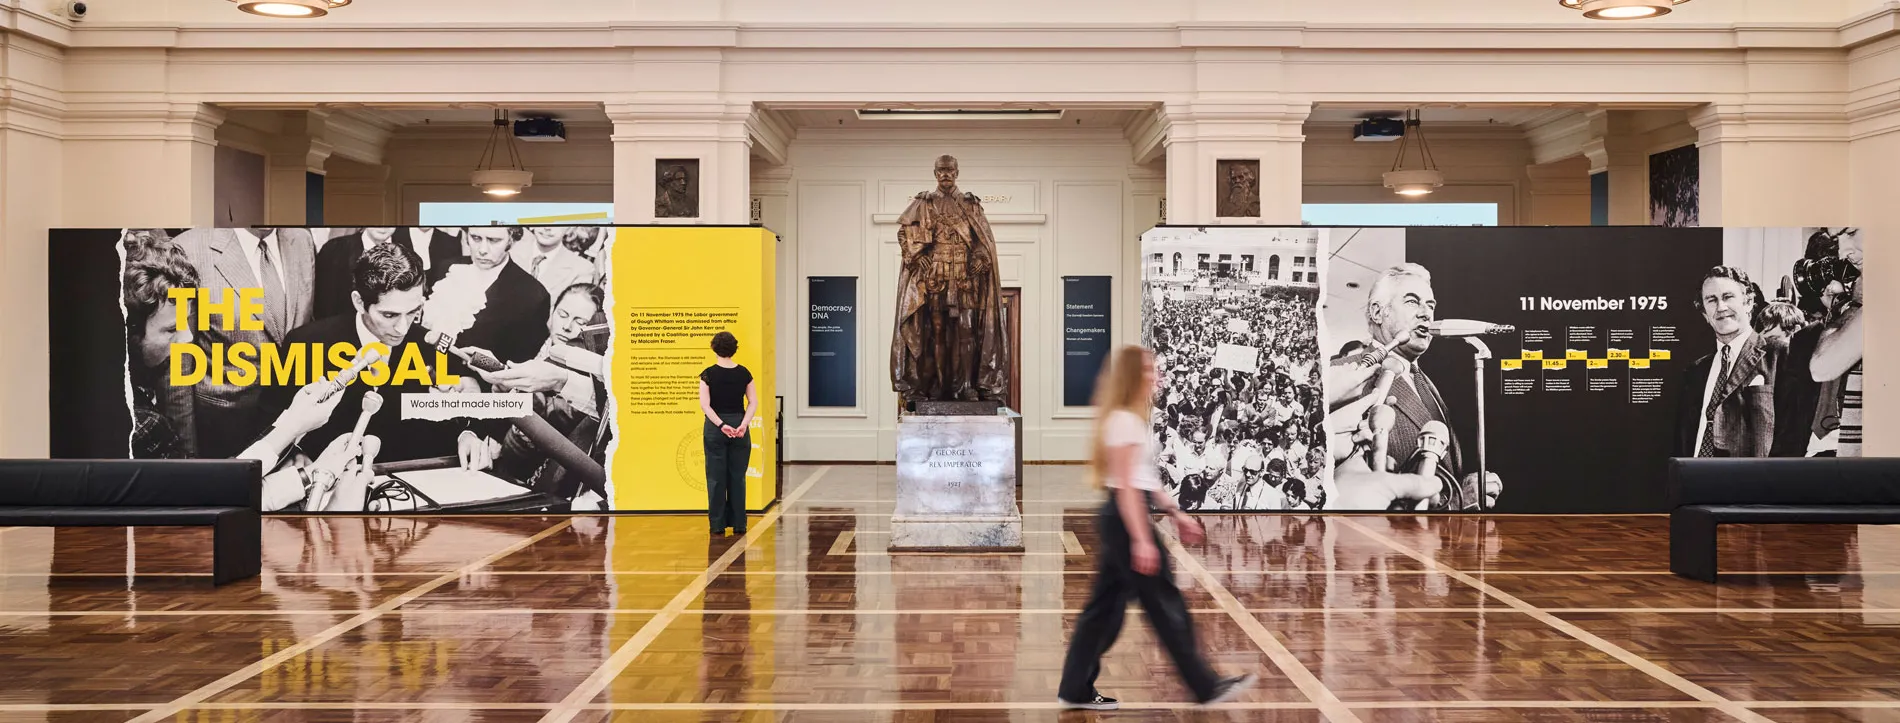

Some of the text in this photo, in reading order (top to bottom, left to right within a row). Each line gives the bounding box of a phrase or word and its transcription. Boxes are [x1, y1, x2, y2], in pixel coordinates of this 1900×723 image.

[167, 287, 265, 331] THE
[811, 304, 852, 313] Democracy
[1520, 296, 1668, 311] 11 November 1975
[437, 335, 451, 353] 2UE
[169, 342, 460, 387] DISMISSAL
[410, 400, 524, 410] Words that made history
